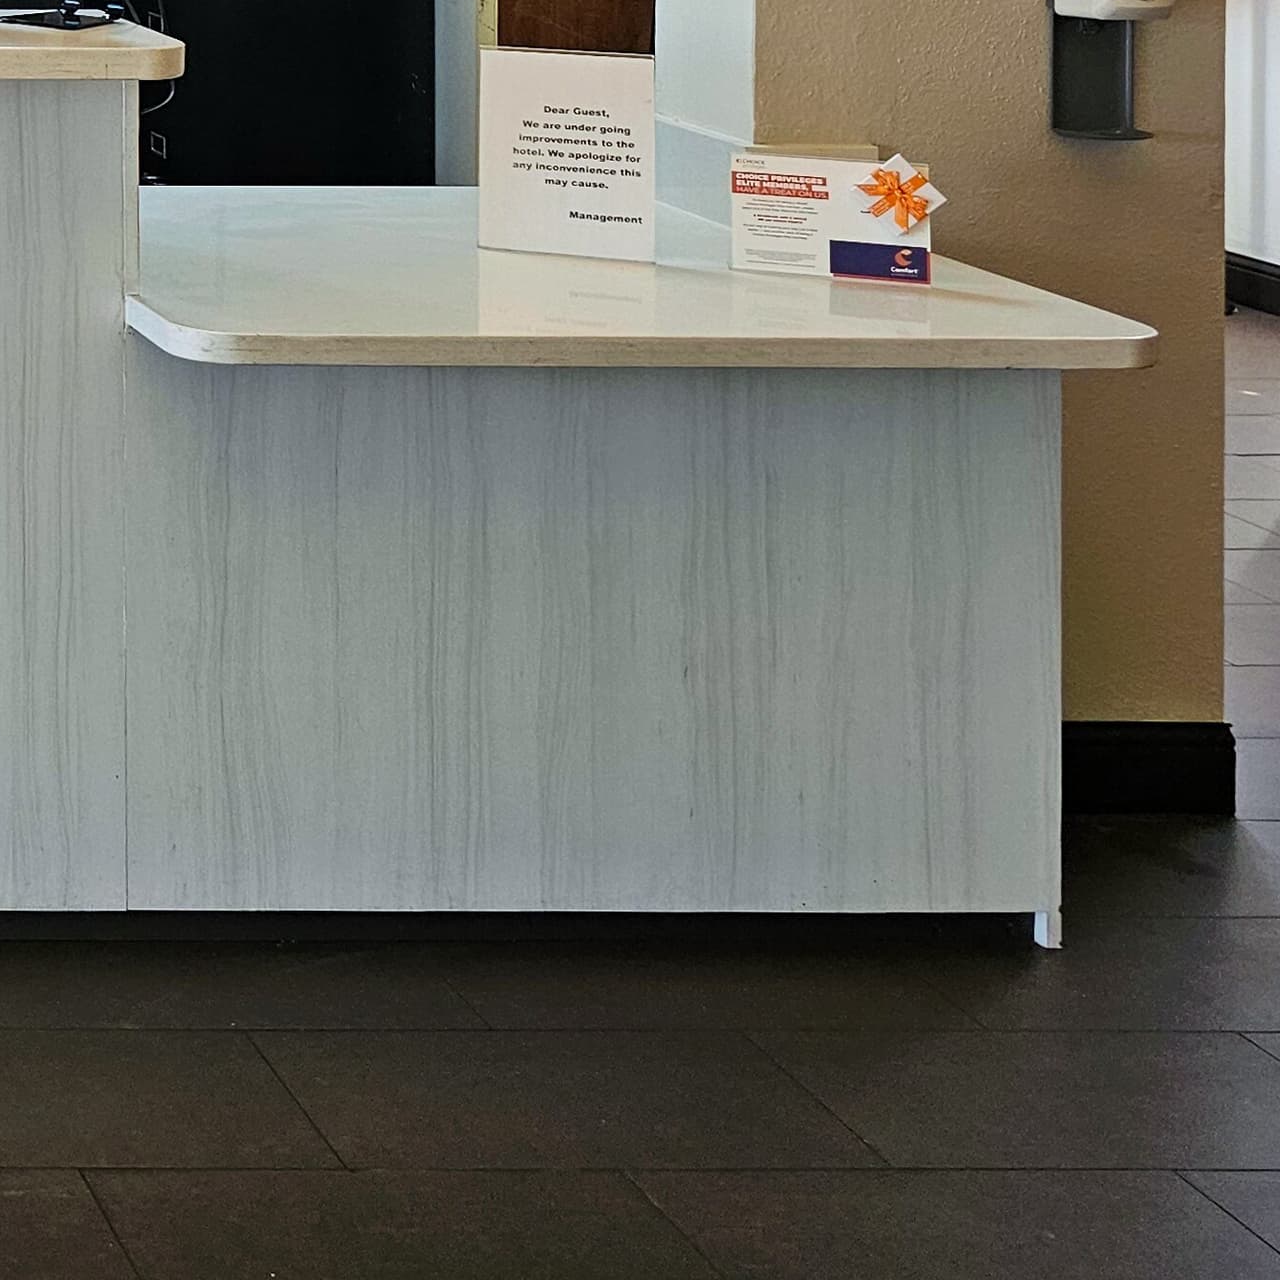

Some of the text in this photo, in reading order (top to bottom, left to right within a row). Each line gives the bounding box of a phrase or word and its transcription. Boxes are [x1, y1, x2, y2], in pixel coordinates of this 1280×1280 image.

[543, 106, 610, 118] Dear Guest,
[523, 120, 540, 129] We
[564, 124, 597, 132] under
[600, 126, 631, 136] going
[519, 133, 635, 149] improvements to the
[512, 147, 641, 163] hotel. We apologize for
[512, 161, 641, 178] any inconvenience this
[545, 178, 609, 190] may cause.
[735, 173, 823, 185] CHOICE PRIVILEGES
[735, 179, 760, 187] ELITE
[736, 186, 760, 194] HAVE
[770, 188, 797, 196] TREAT
[569, 211, 643, 225] Management
[890, 266, 919, 274] Comfort
